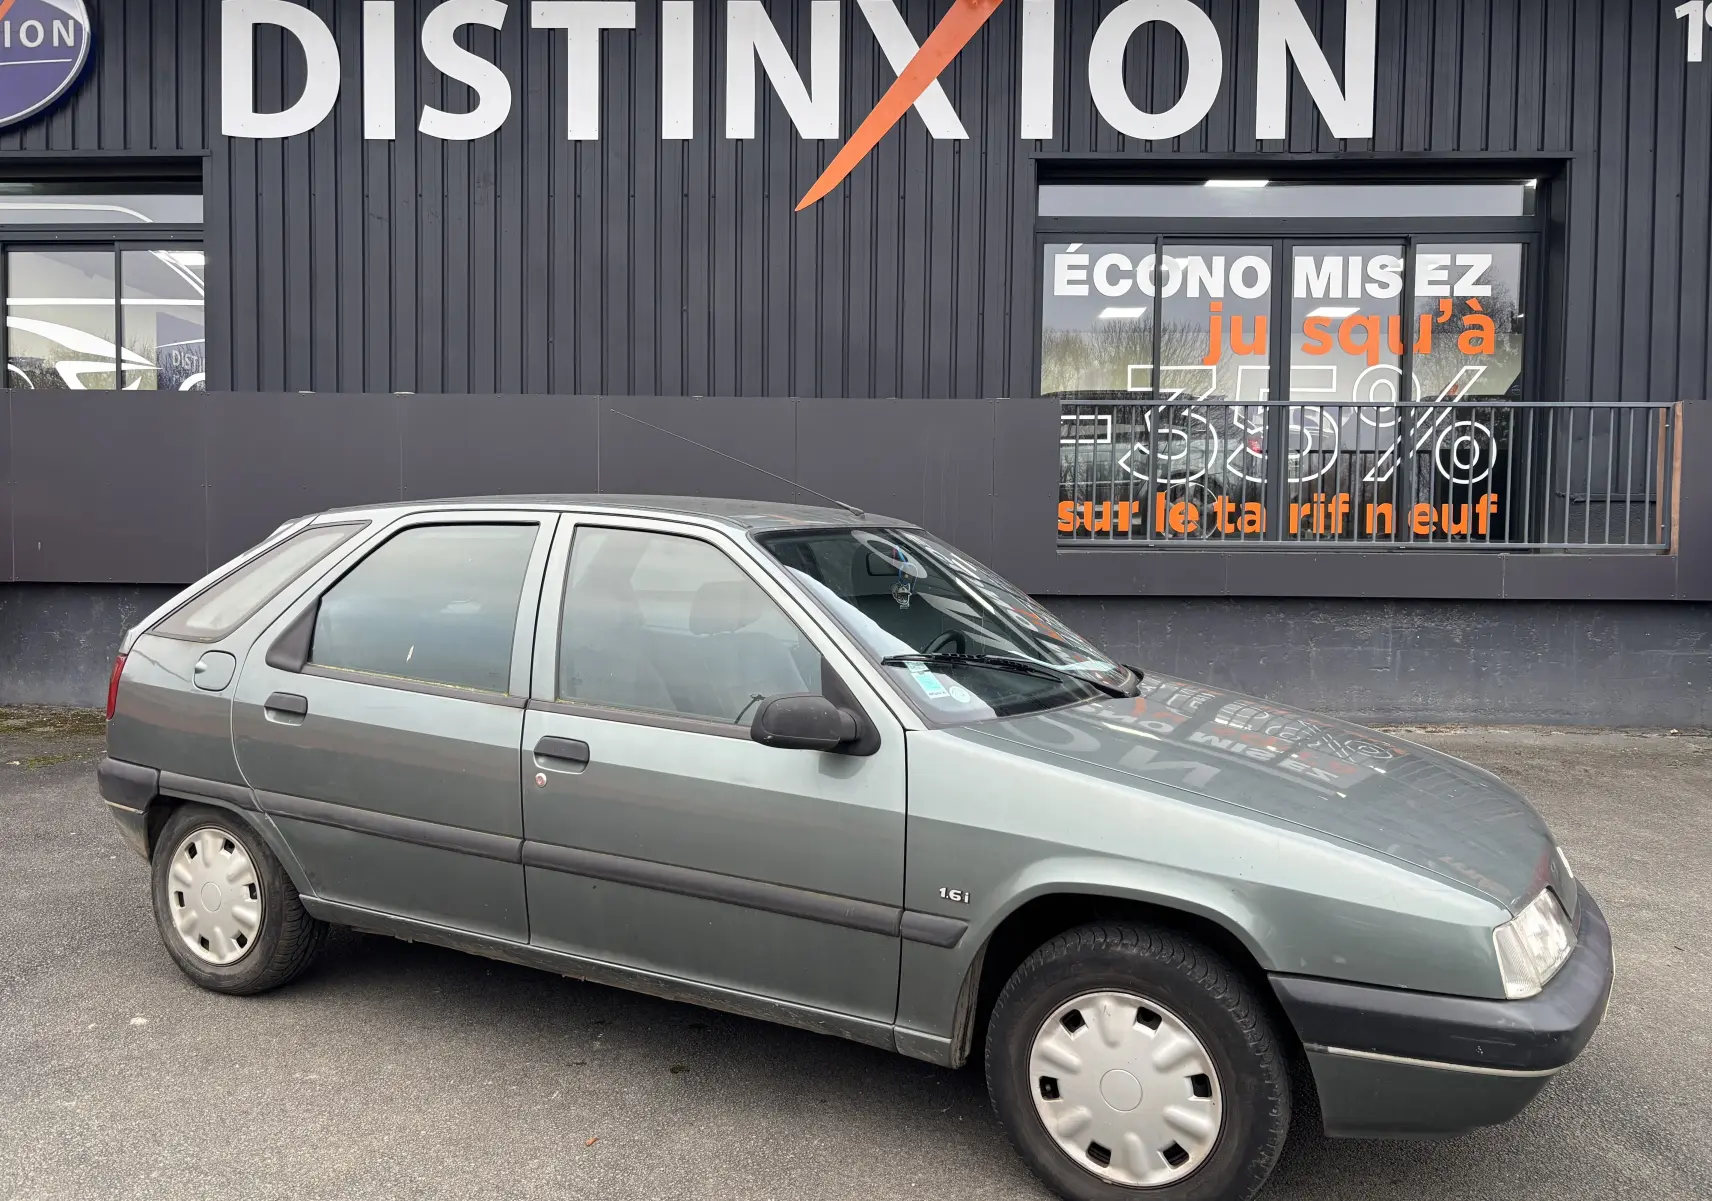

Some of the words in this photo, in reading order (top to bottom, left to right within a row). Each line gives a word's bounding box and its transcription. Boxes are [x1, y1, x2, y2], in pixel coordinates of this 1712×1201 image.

[221, 0, 1375, 211] DISTINXION
[1057, 497, 1139, 533] sur
[1155, 491, 1200, 534] le
